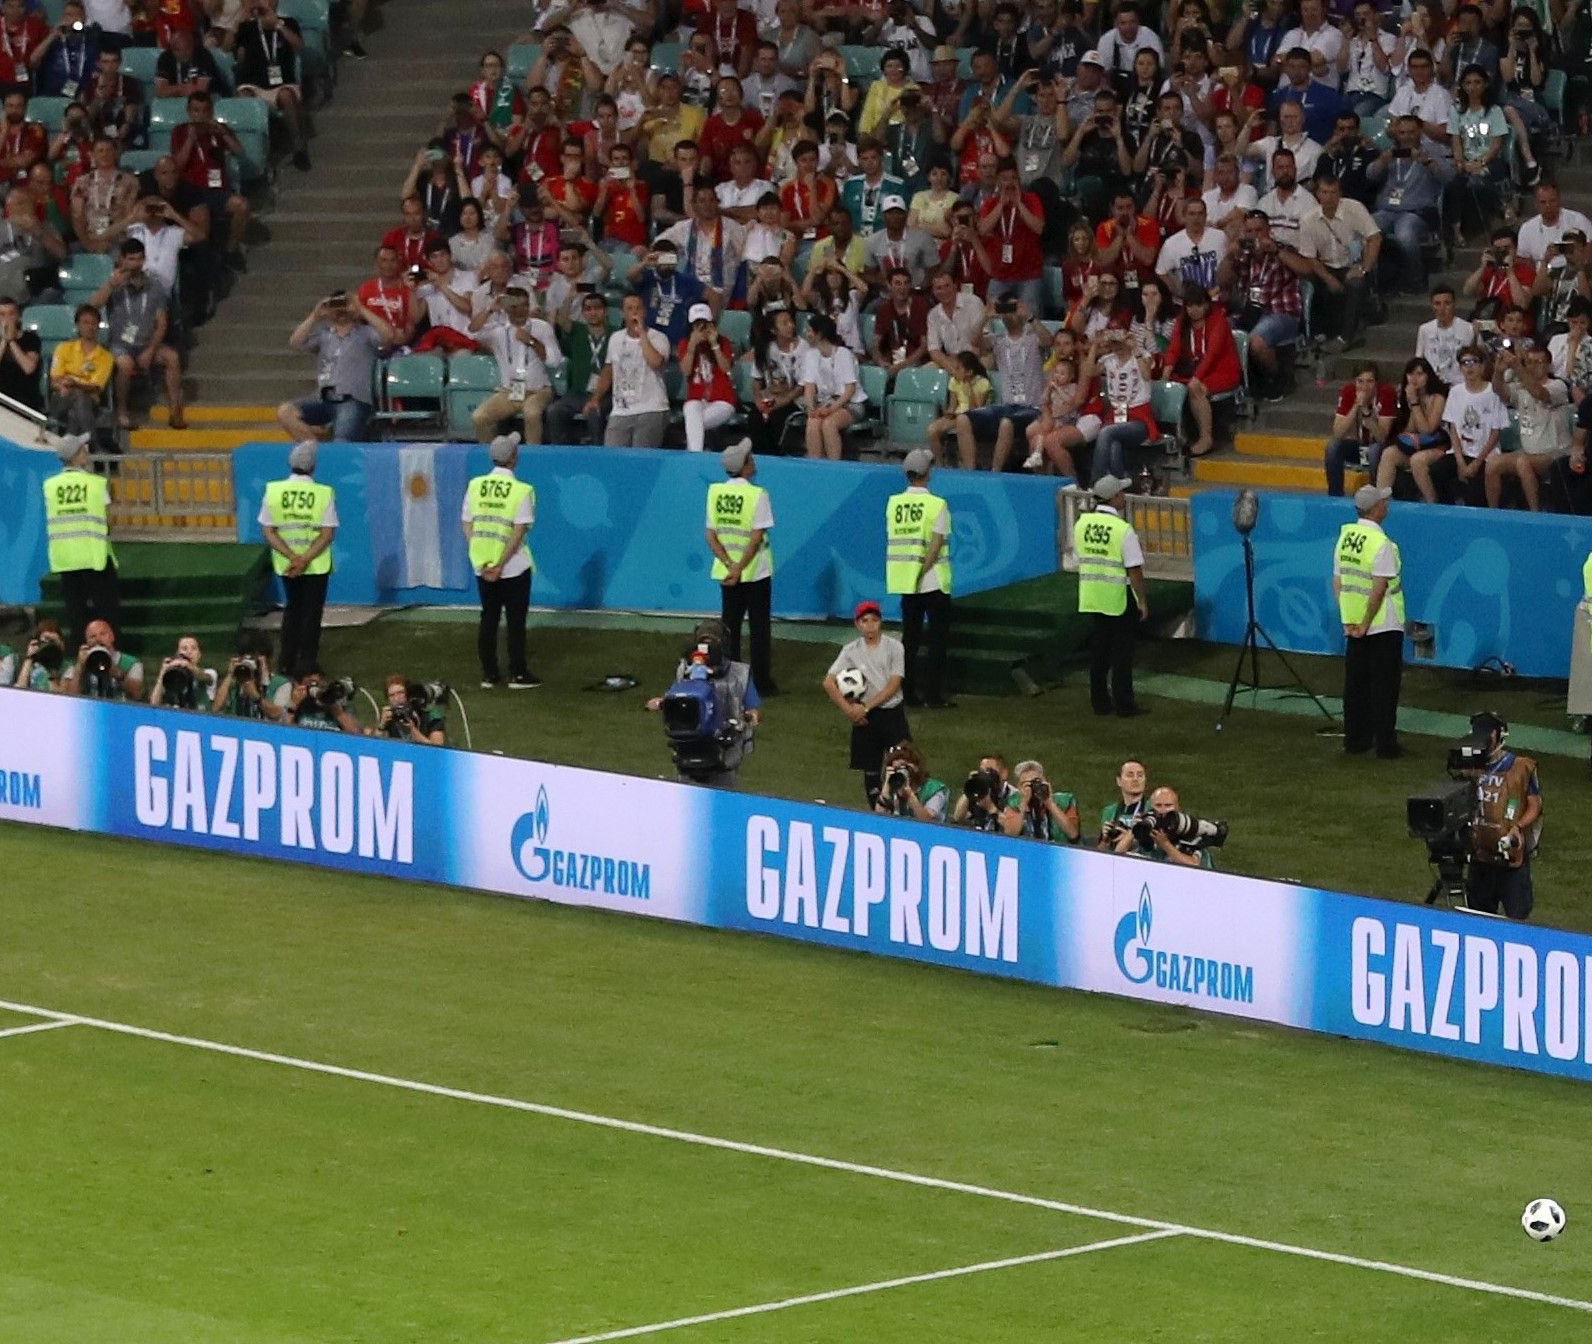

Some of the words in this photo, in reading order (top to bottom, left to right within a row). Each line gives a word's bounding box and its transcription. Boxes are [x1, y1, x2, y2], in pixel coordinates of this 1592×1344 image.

[57, 484, 87, 505] 9221
[281, 490, 315, 510] 8750
[895, 502, 924, 524] 8766
[134, 705, 414, 865] GAZPROM
[552, 848, 651, 904] GAZPROM
[746, 814, 1019, 963] GAZPROM
[1155, 954, 1255, 1004] GAZPROM
